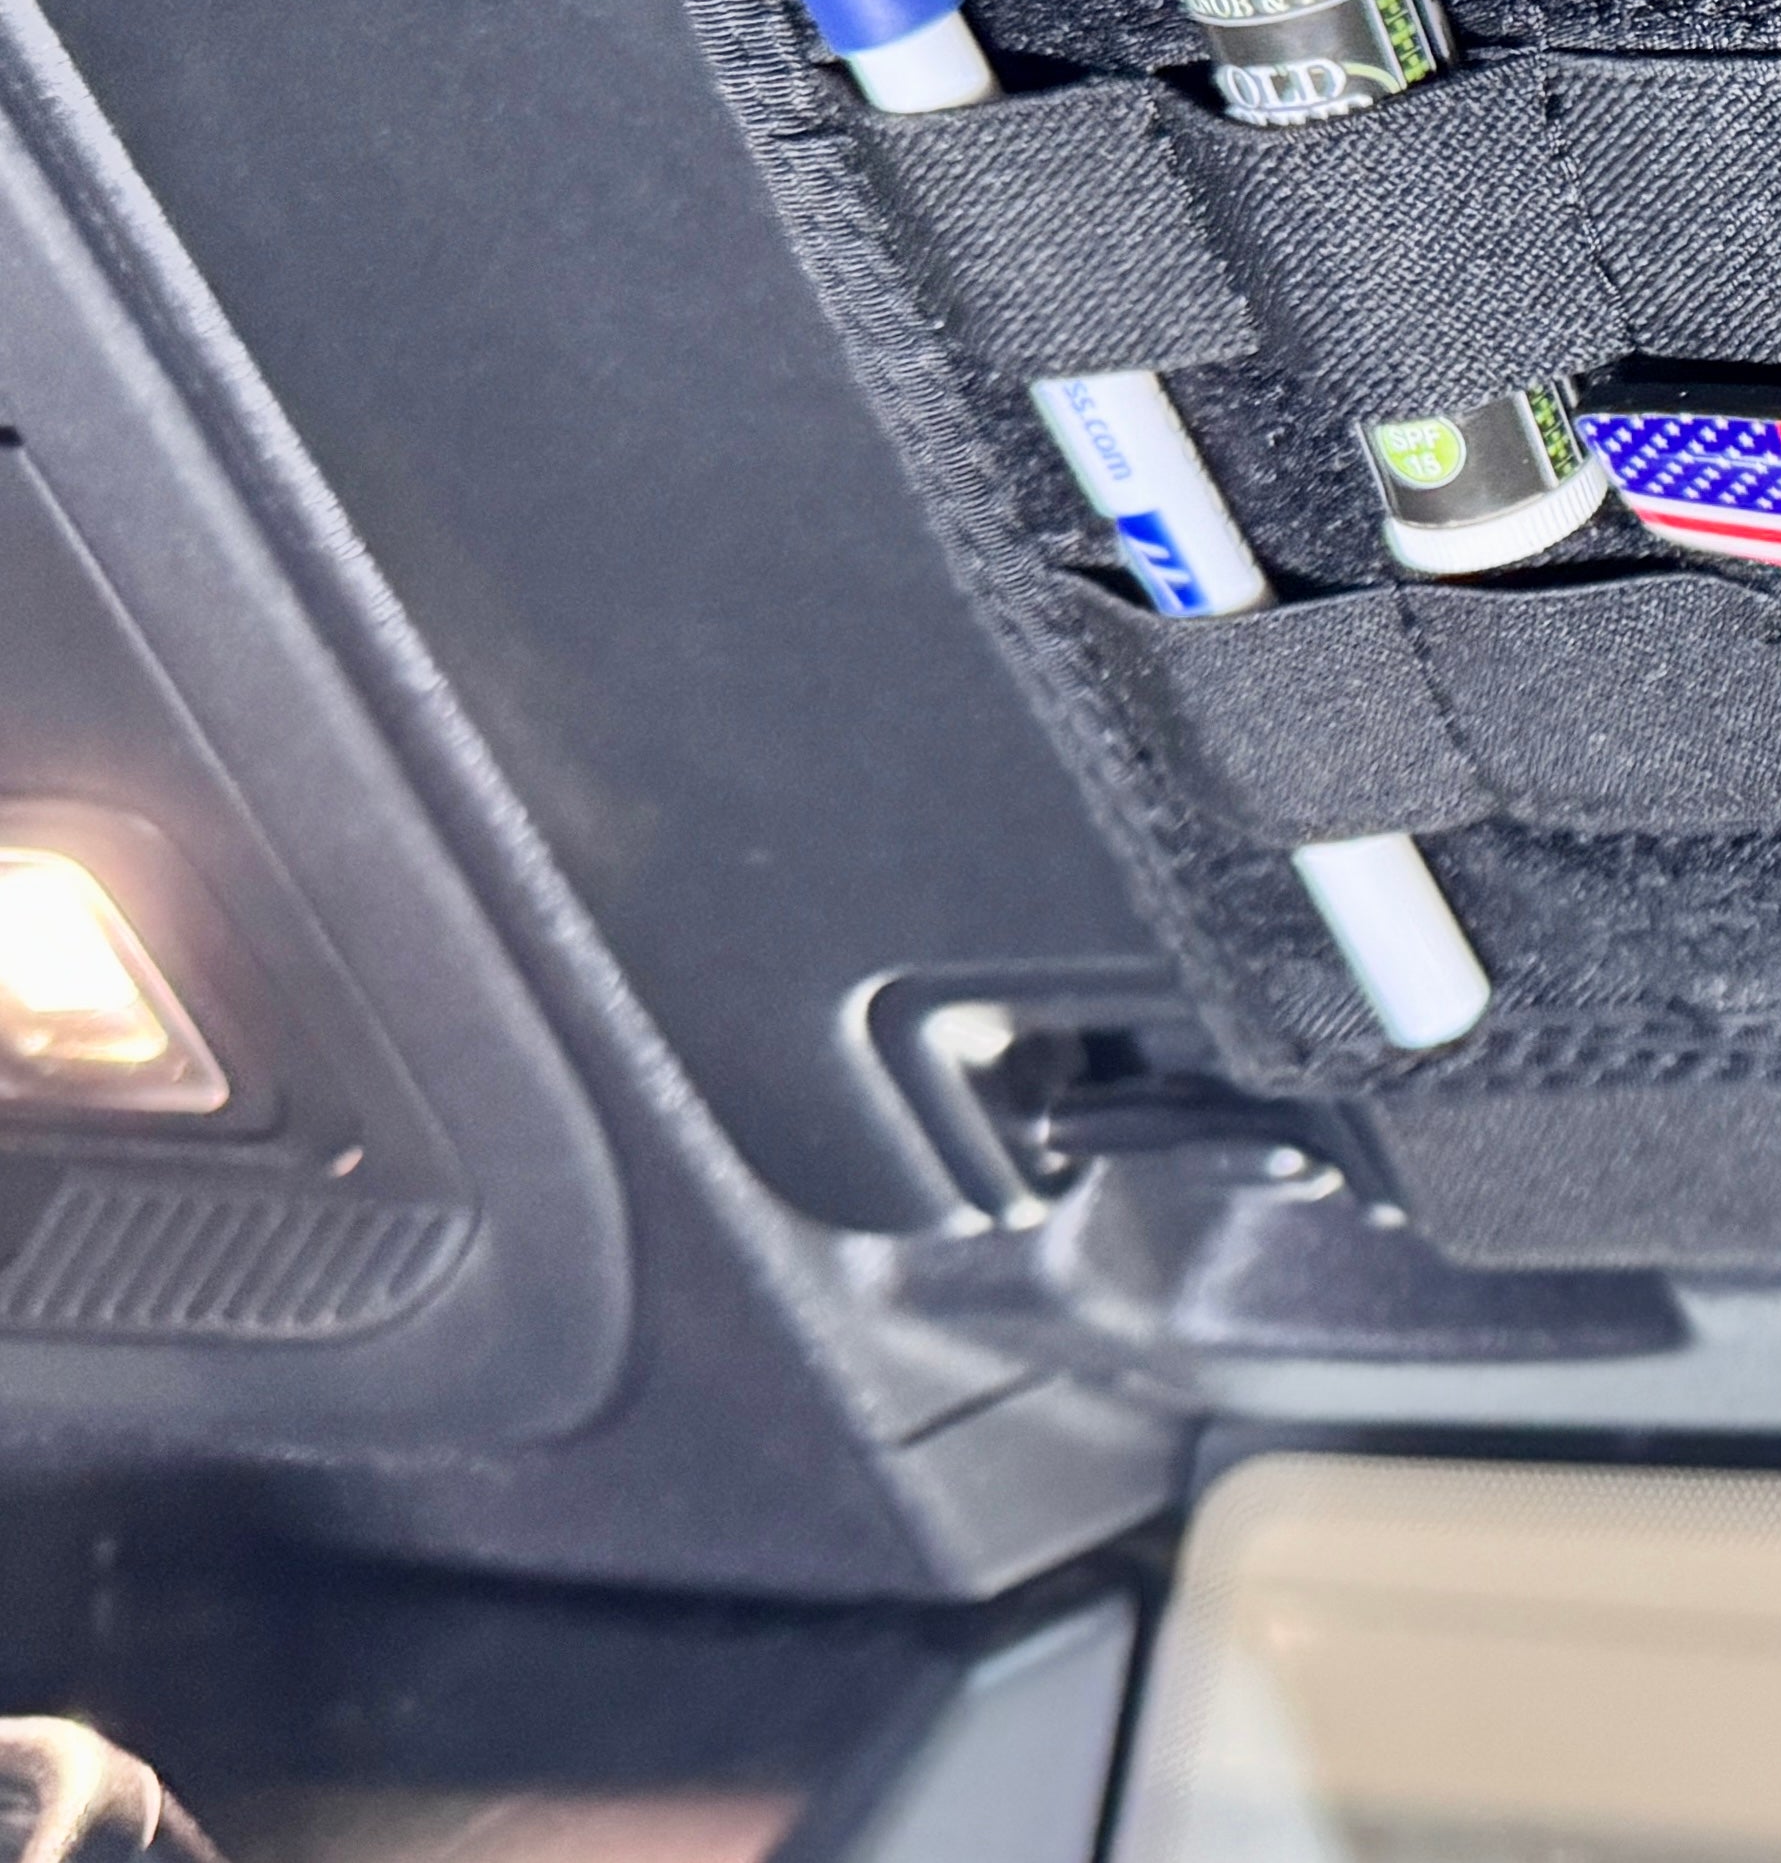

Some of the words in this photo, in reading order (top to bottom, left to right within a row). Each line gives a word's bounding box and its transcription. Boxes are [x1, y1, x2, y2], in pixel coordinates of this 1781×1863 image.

[1217, 58, 1348, 110] OLD
[1389, 423, 1442, 453] SPF
[1405, 452, 1442, 477] 15
